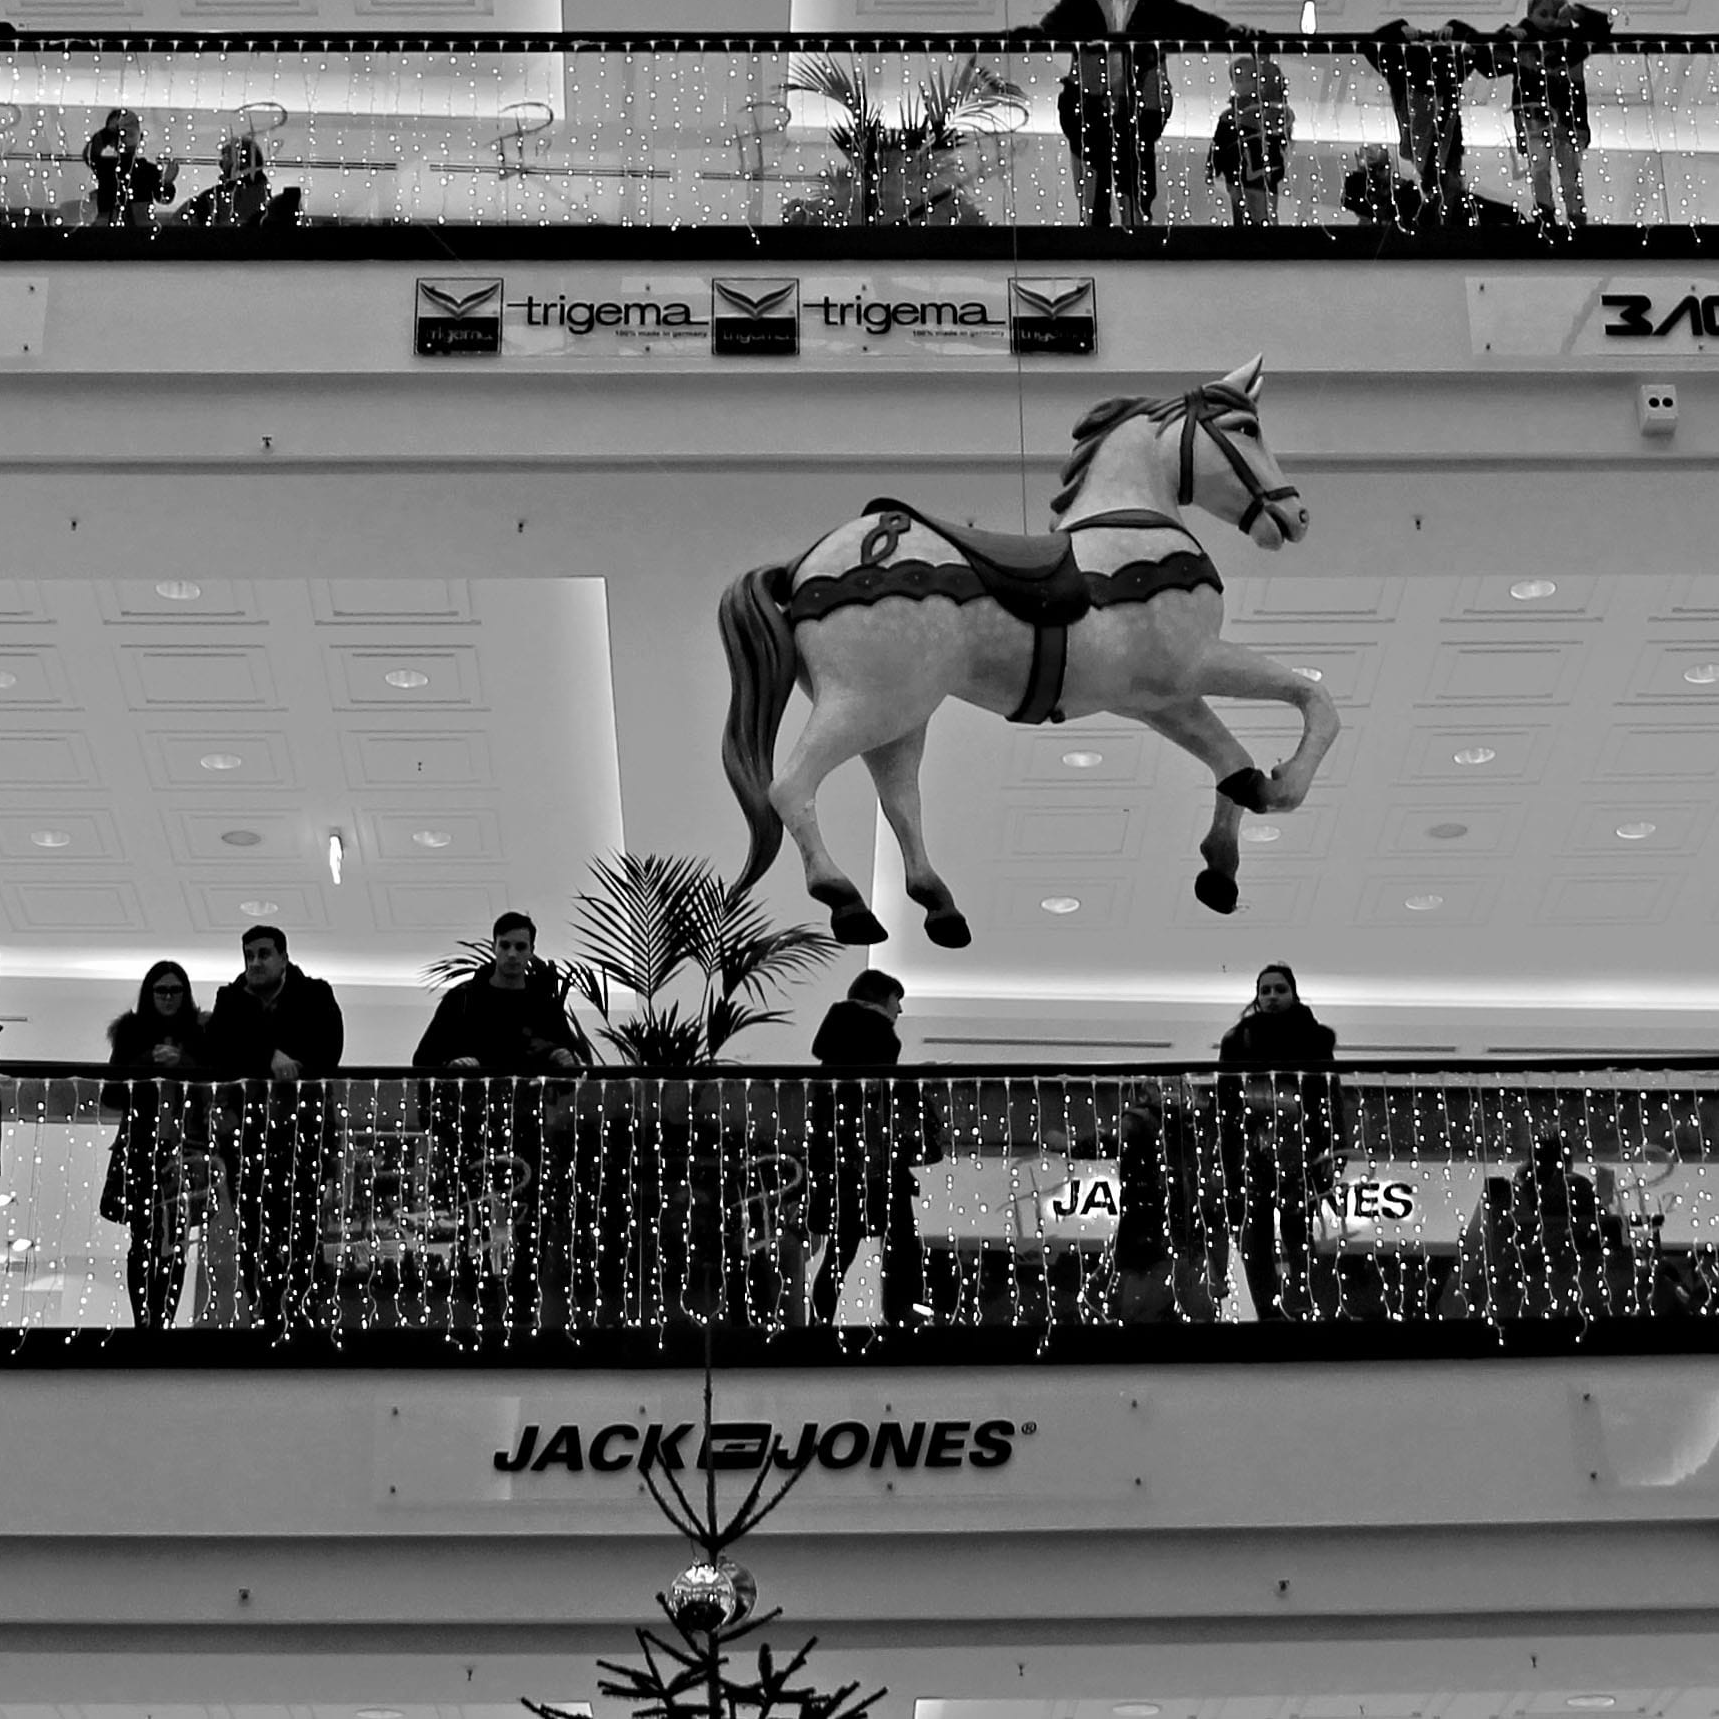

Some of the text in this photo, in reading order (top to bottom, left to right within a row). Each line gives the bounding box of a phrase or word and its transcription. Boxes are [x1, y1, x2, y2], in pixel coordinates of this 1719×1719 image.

[507, 295, 709, 335] trigema
[803, 295, 1006, 335] trigema
[493, 1422, 695, 1471] JACK
